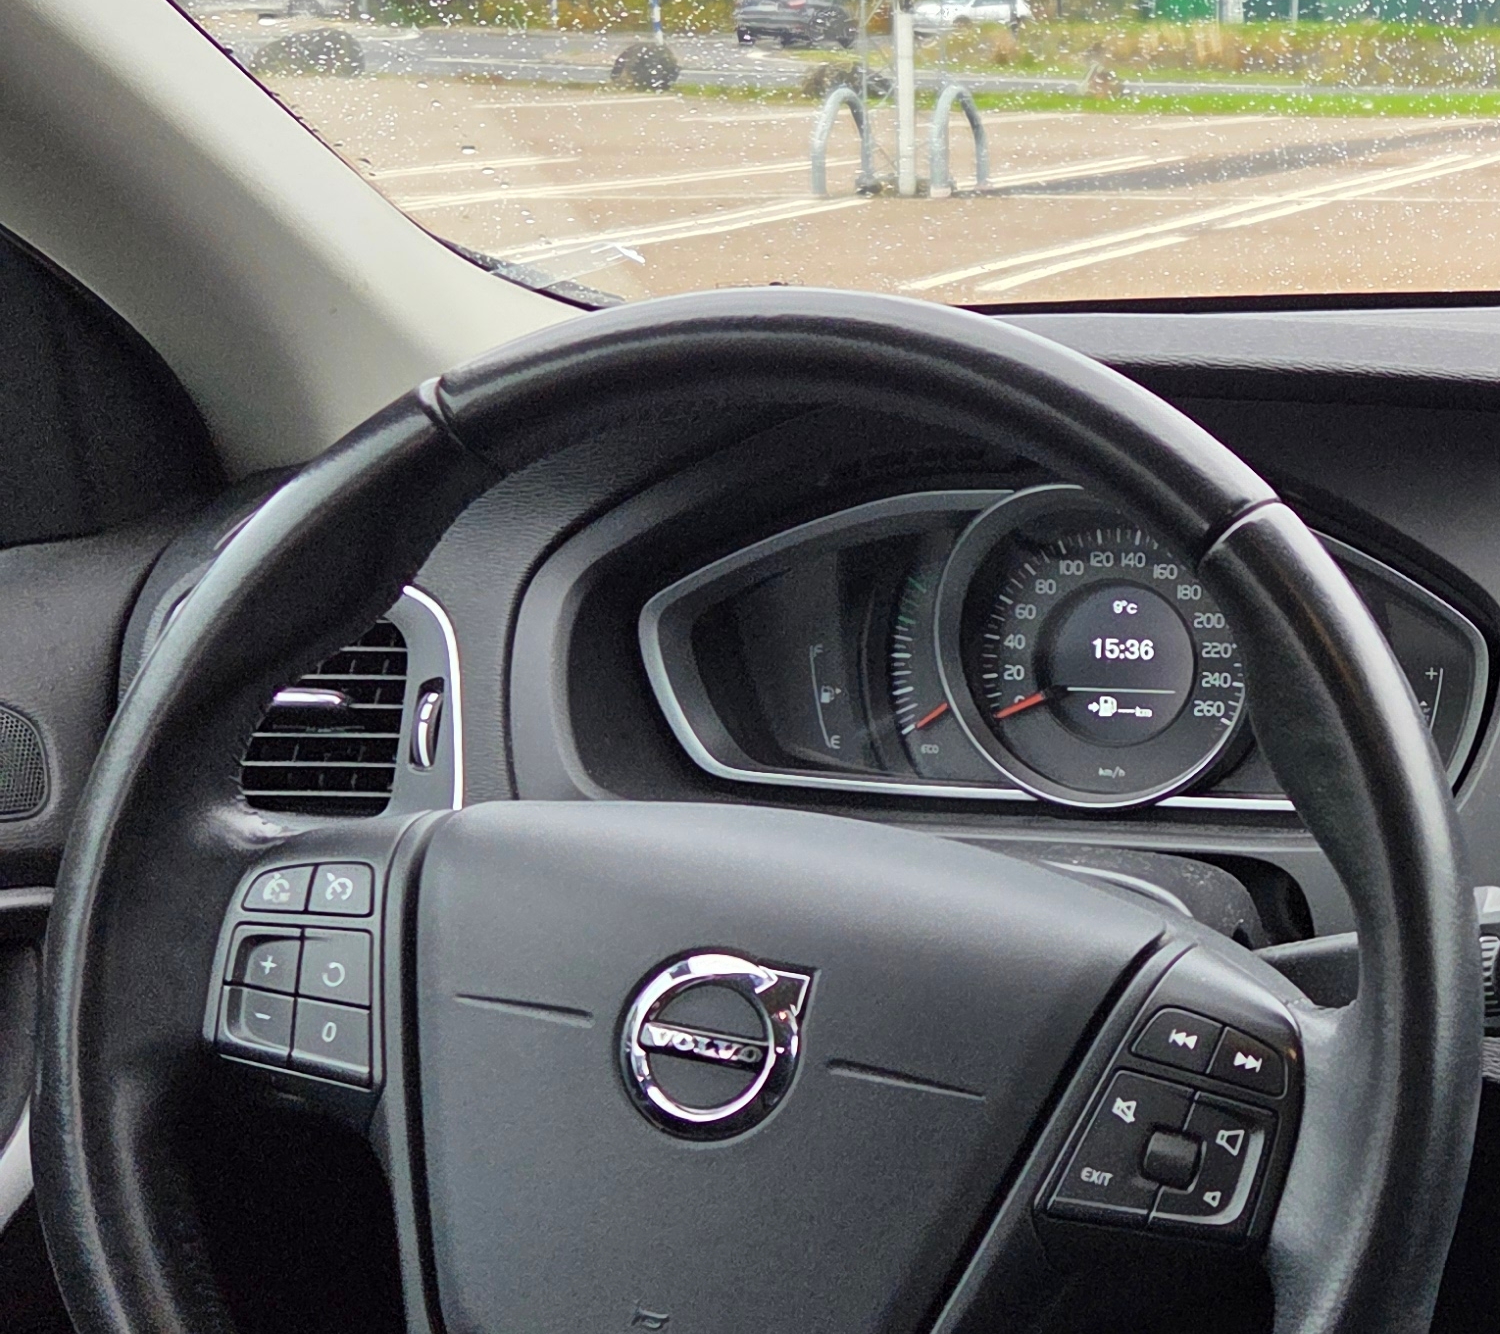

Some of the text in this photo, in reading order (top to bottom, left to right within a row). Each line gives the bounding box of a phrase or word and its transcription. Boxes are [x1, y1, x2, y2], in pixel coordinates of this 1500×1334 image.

[1059, 560, 1084, 576] 100
[1090, 552, 1114, 568] 120
[1121, 552, 1146, 569] 140
[1153, 563, 1178, 581] 160
[1035, 579, 1057, 595] 80
[1177, 584, 1202, 601] 180
[1015, 604, 1036, 620] 60
[1193, 613, 1225, 629] 200
[1004, 635, 1026, 650] 40
[1092, 637, 1155, 660] 15:36
[1202, 642, 1231, 659] 220
[1004, 665, 1025, 681] 20
[1202, 672, 1231, 688] 240
[1193, 700, 1225, 717] 260
[651, 1027, 763, 1063] VOLVO
[1080, 1167, 1113, 1186] EXIT
